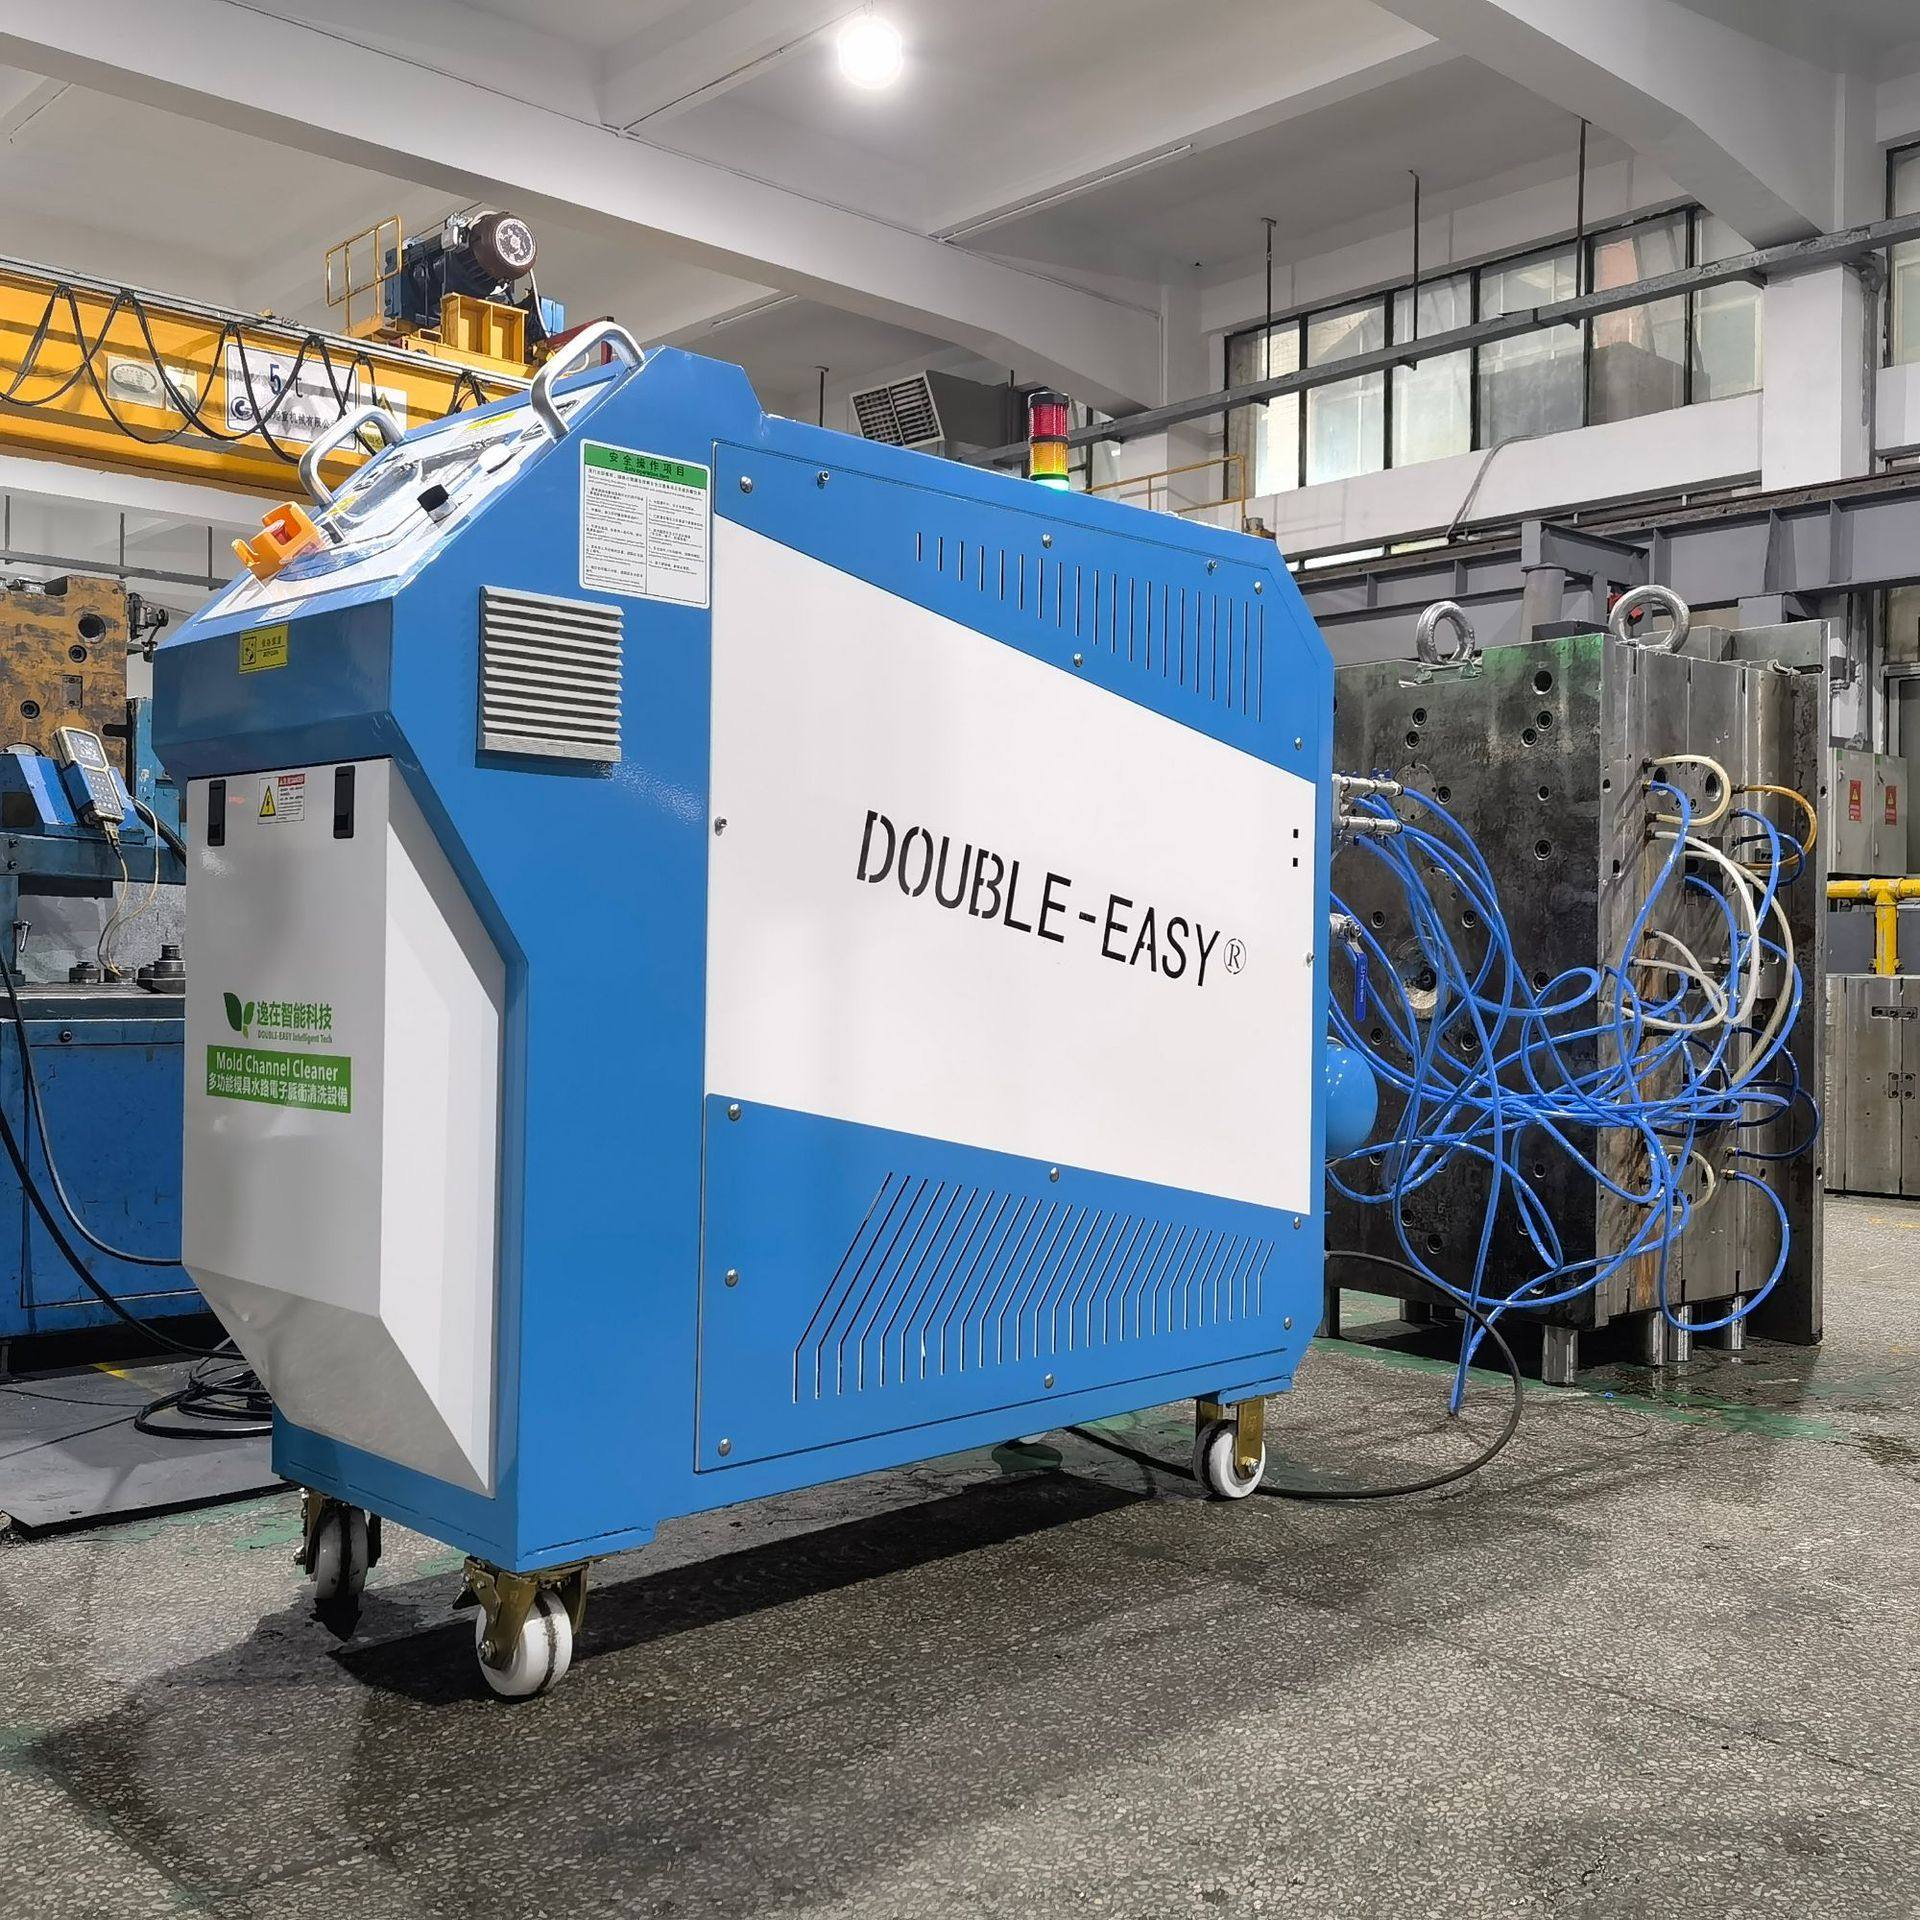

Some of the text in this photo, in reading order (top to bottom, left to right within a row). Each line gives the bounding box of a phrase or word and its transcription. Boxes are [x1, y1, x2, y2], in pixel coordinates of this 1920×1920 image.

[268, 363, 282, 395] 5
[216, 1051, 339, 1082] Mold Channel Cleaner
